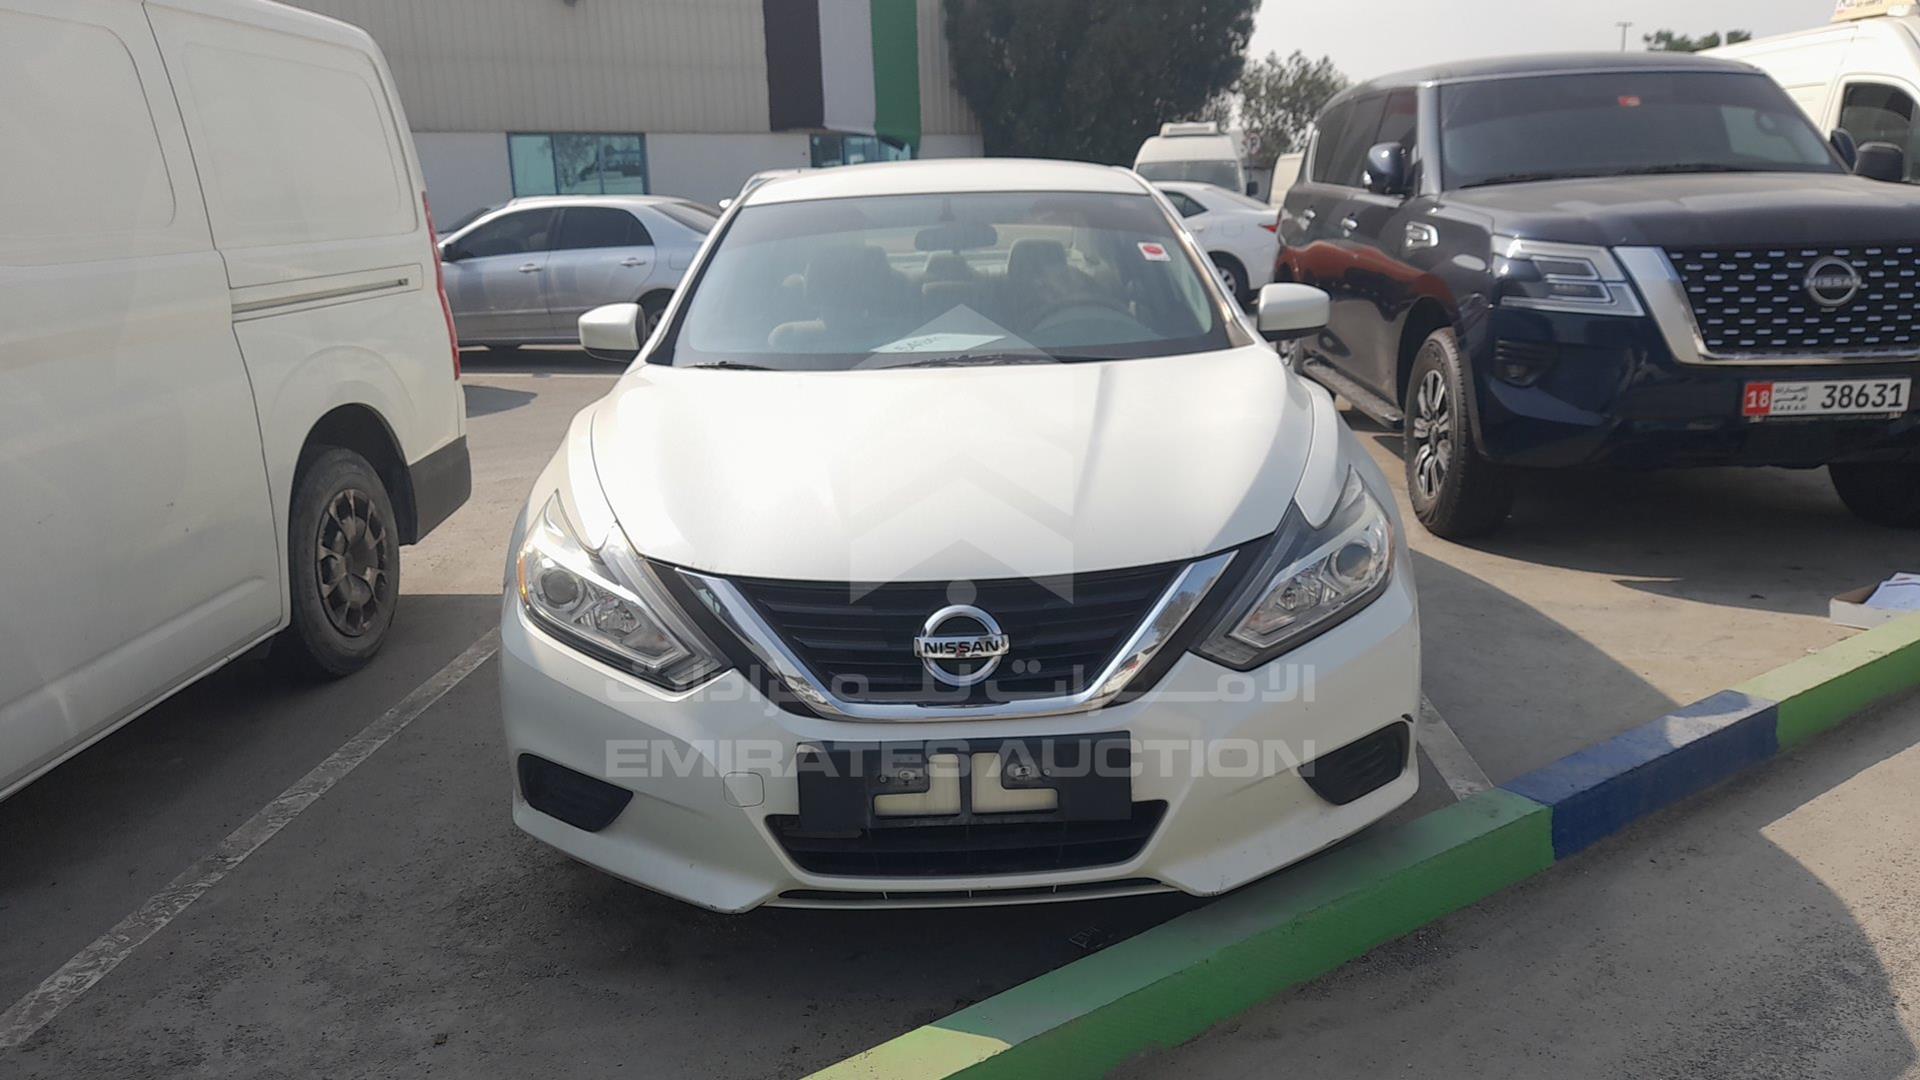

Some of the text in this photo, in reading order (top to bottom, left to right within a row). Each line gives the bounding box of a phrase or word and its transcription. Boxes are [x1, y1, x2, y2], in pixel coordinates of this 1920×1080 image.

[1804, 276, 1861, 288] NISSAN
[1746, 383, 1903, 409] 18 38631
[923, 639, 999, 655] NISSAN
